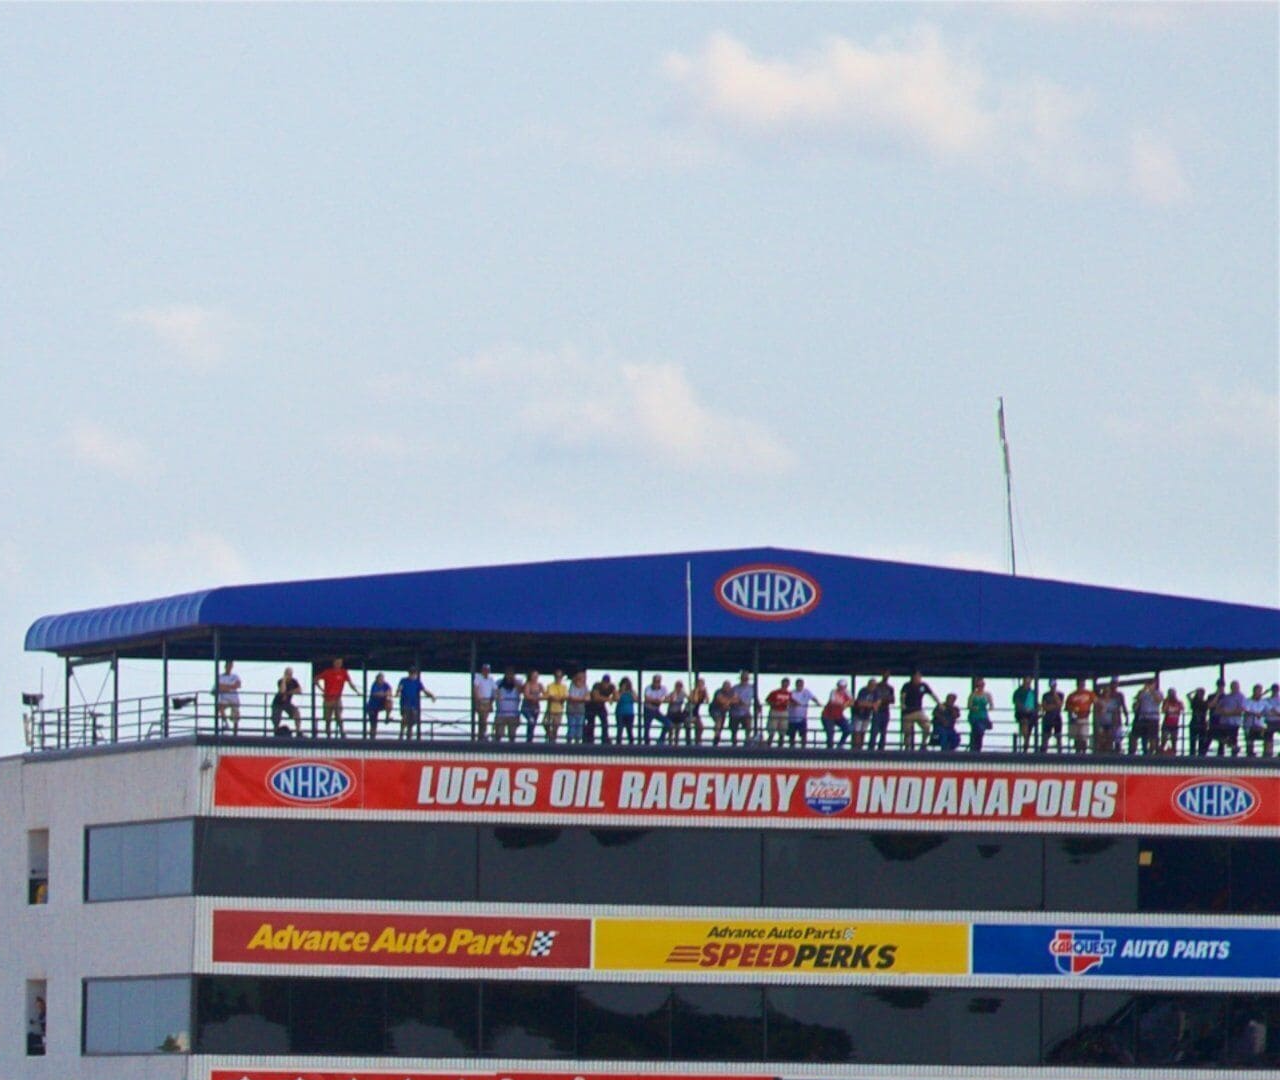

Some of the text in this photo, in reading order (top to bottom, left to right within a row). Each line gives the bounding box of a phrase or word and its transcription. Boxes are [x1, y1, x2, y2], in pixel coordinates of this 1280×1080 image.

[731, 572, 808, 610] NHRA
[275, 768, 349, 799] NHRA
[417, 765, 799, 813] LUCAS OIL RACEWAY
[855, 775, 1119, 818] INDIANAPOLIS
[1182, 783, 1250, 815] NHRA
[247, 923, 528, 956] Advance Auto Parts
[707, 926, 843, 940] Advance Auto Parts
[699, 942, 899, 969] SPEEDPERKS
[1120, 940, 1231, 960] AUTO PARTS
